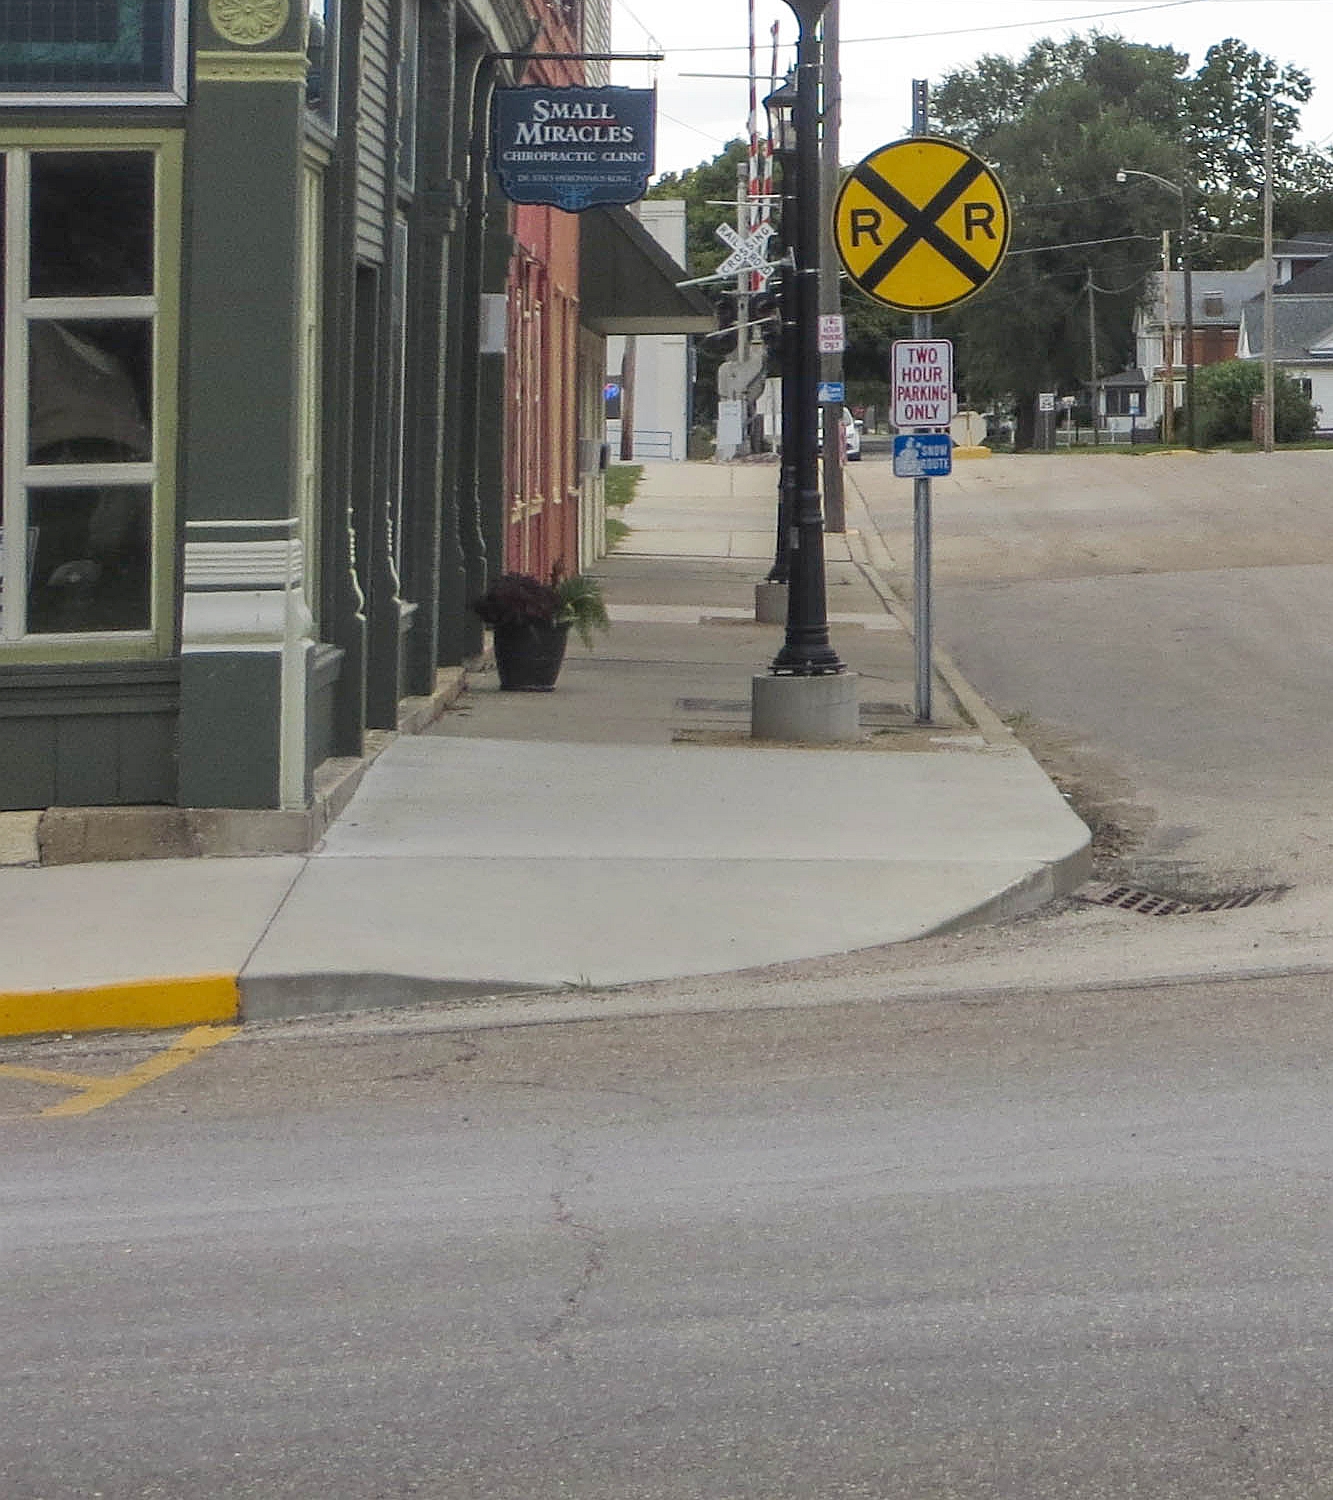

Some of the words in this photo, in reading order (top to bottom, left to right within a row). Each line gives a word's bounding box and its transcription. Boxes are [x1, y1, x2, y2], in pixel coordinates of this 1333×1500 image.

[533, 100, 616, 122] SMALL
[513, 122, 634, 145] MIRACLES
[503, 151, 597, 162] CHIROPRACTIC
[602, 152, 646, 162] CLINIC
[851, 208, 883, 247] R
[963, 202, 997, 241] R
[907, 348, 938, 364] TWO
[902, 367, 942, 383] HOUR
[897, 386, 948, 401] PARKING
[905, 404, 940, 420] ONLY
[921, 445, 948, 456] SNOW
